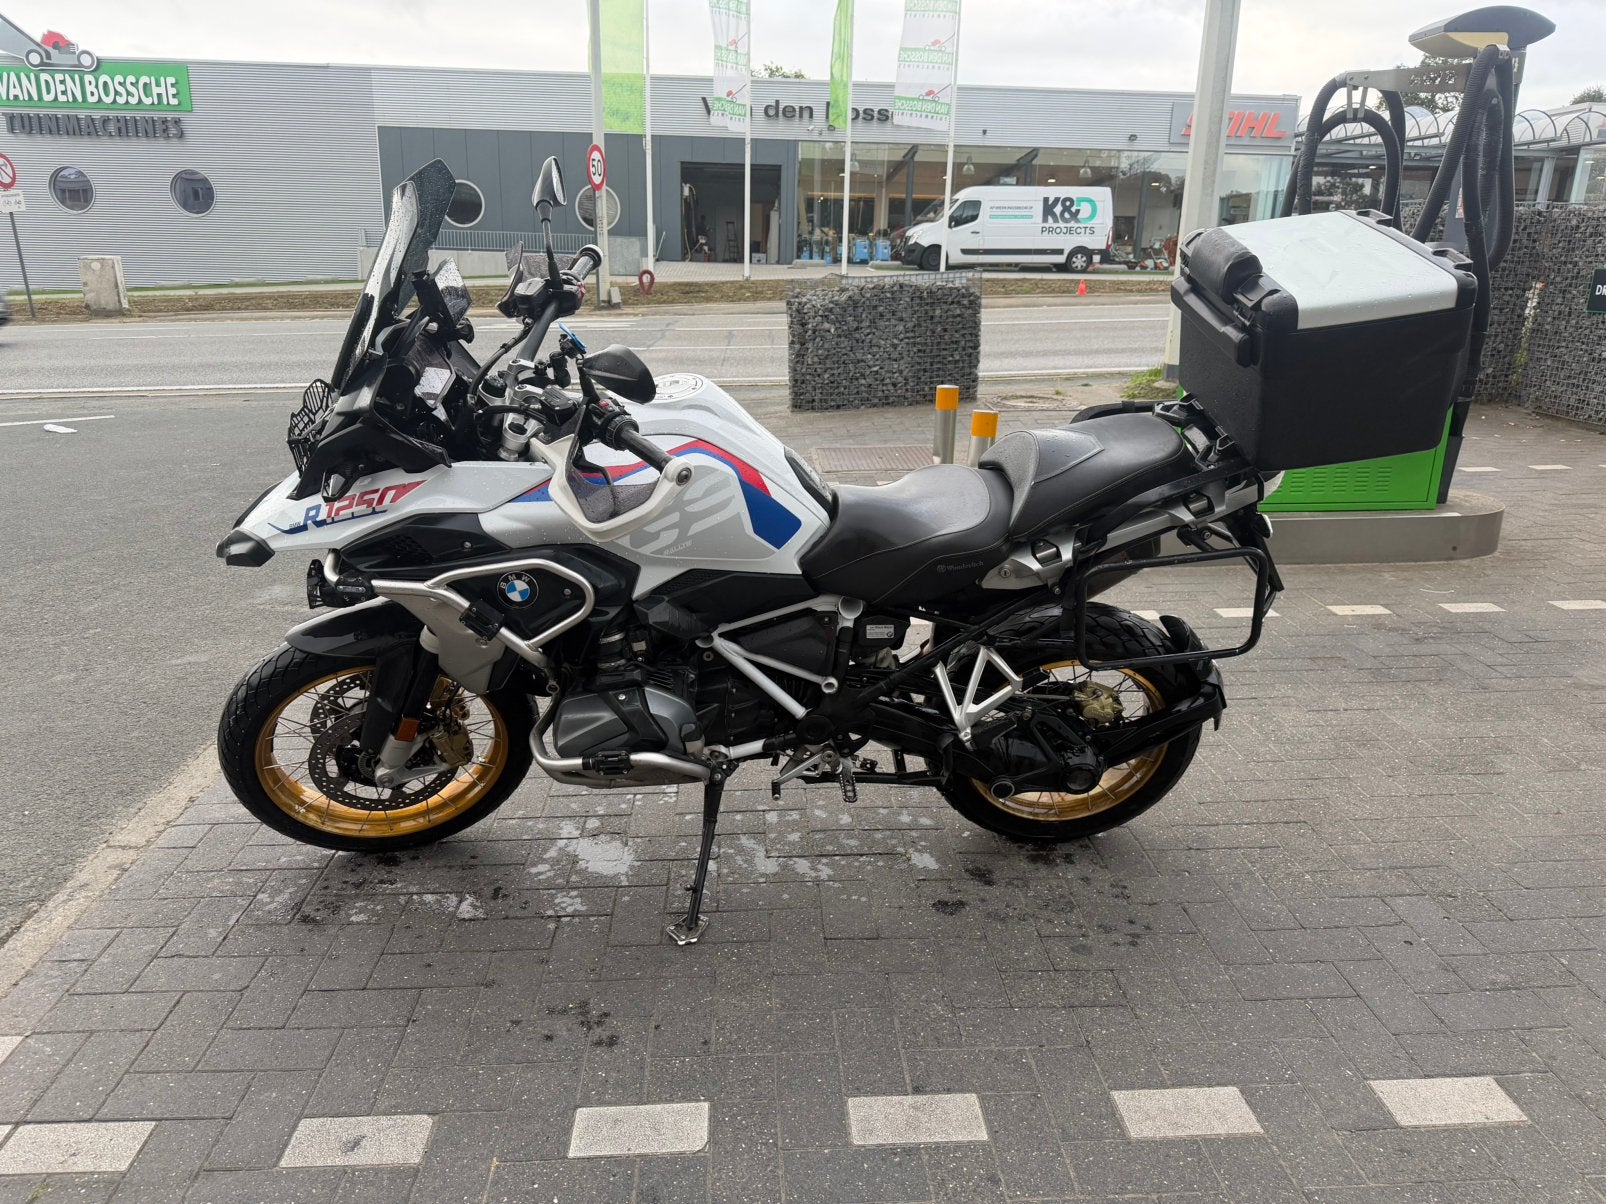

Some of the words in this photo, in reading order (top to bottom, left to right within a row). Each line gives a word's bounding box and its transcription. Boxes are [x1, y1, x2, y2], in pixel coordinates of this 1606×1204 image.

[0, 71, 38, 101] VAN
[40, 73, 82, 102] DEN
[84, 74, 179, 105] BOSSCHE
[764, 100, 814, 118] den
[2, 112, 183, 138] TUINMACHINES
[591, 158, 602, 177] 50
[1041, 196, 1098, 225] K&D
[1041, 226, 1096, 236] PROJECTS
